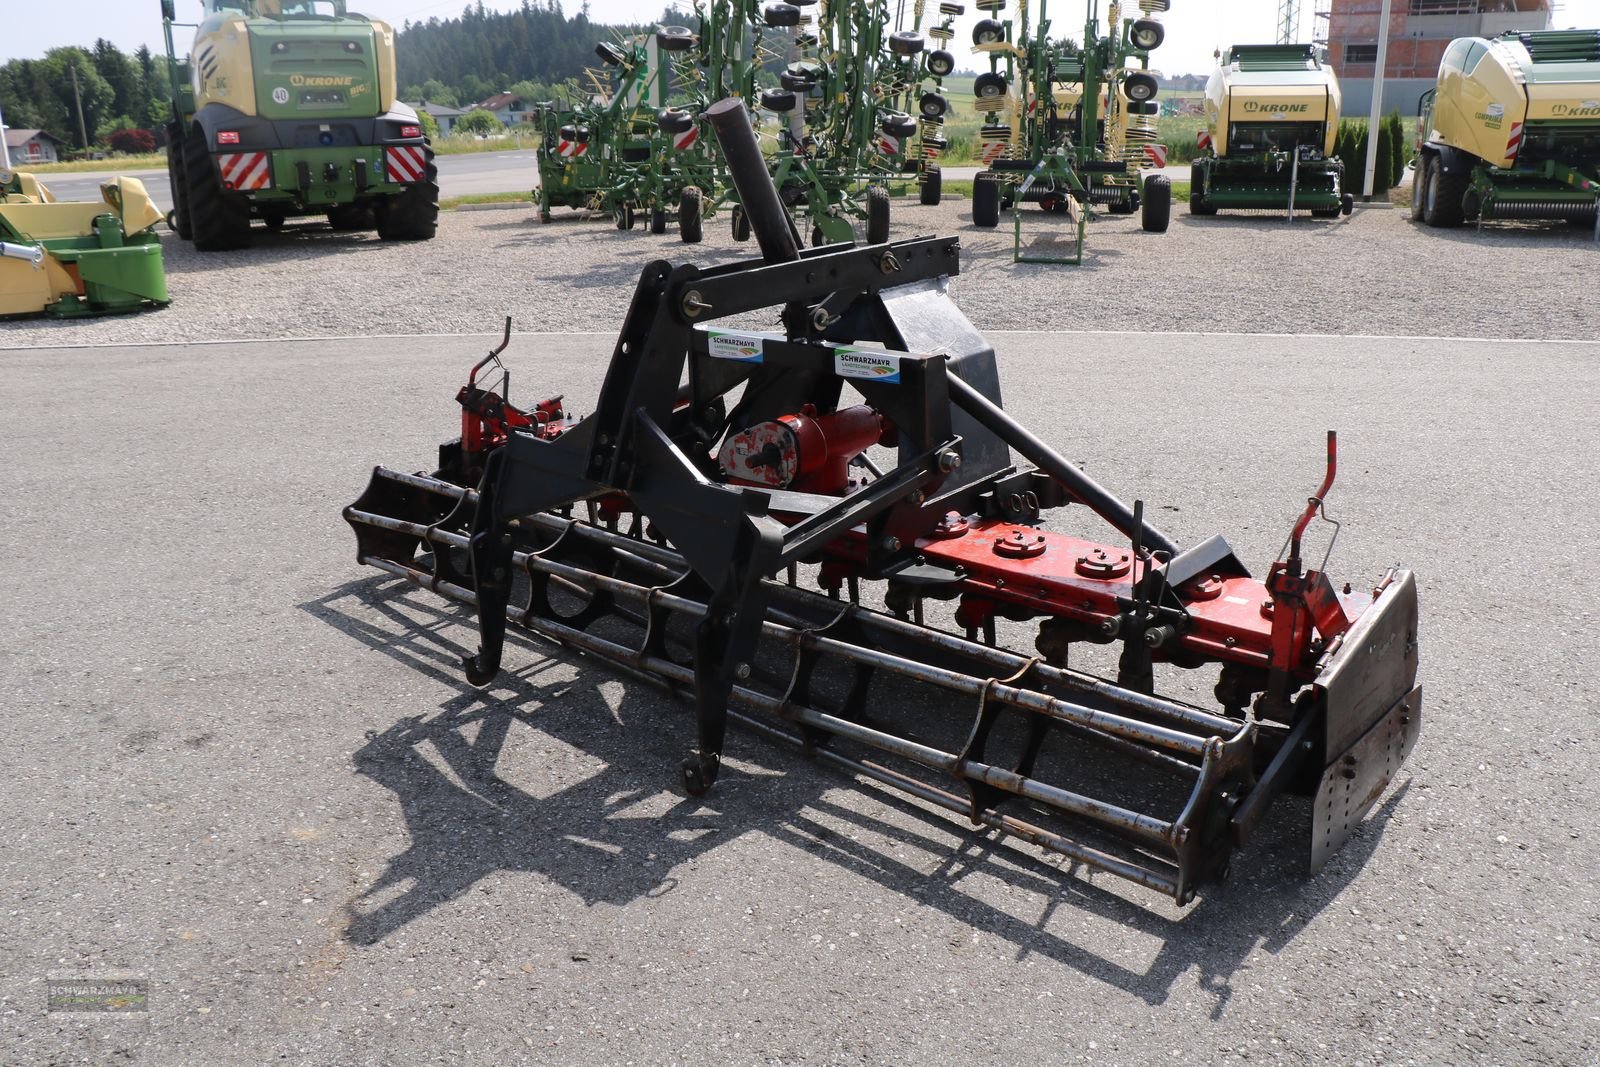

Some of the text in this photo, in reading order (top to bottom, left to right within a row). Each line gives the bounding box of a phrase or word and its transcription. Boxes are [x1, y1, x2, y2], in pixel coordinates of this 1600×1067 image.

[305, 76, 353, 86] KRONE
[274, 89, 287, 100] 40
[1259, 103, 1309, 112] KRONE
[713, 337, 755, 347] SCHWARZMAYR
[840, 354, 890, 366] SCHWARZMAYR
